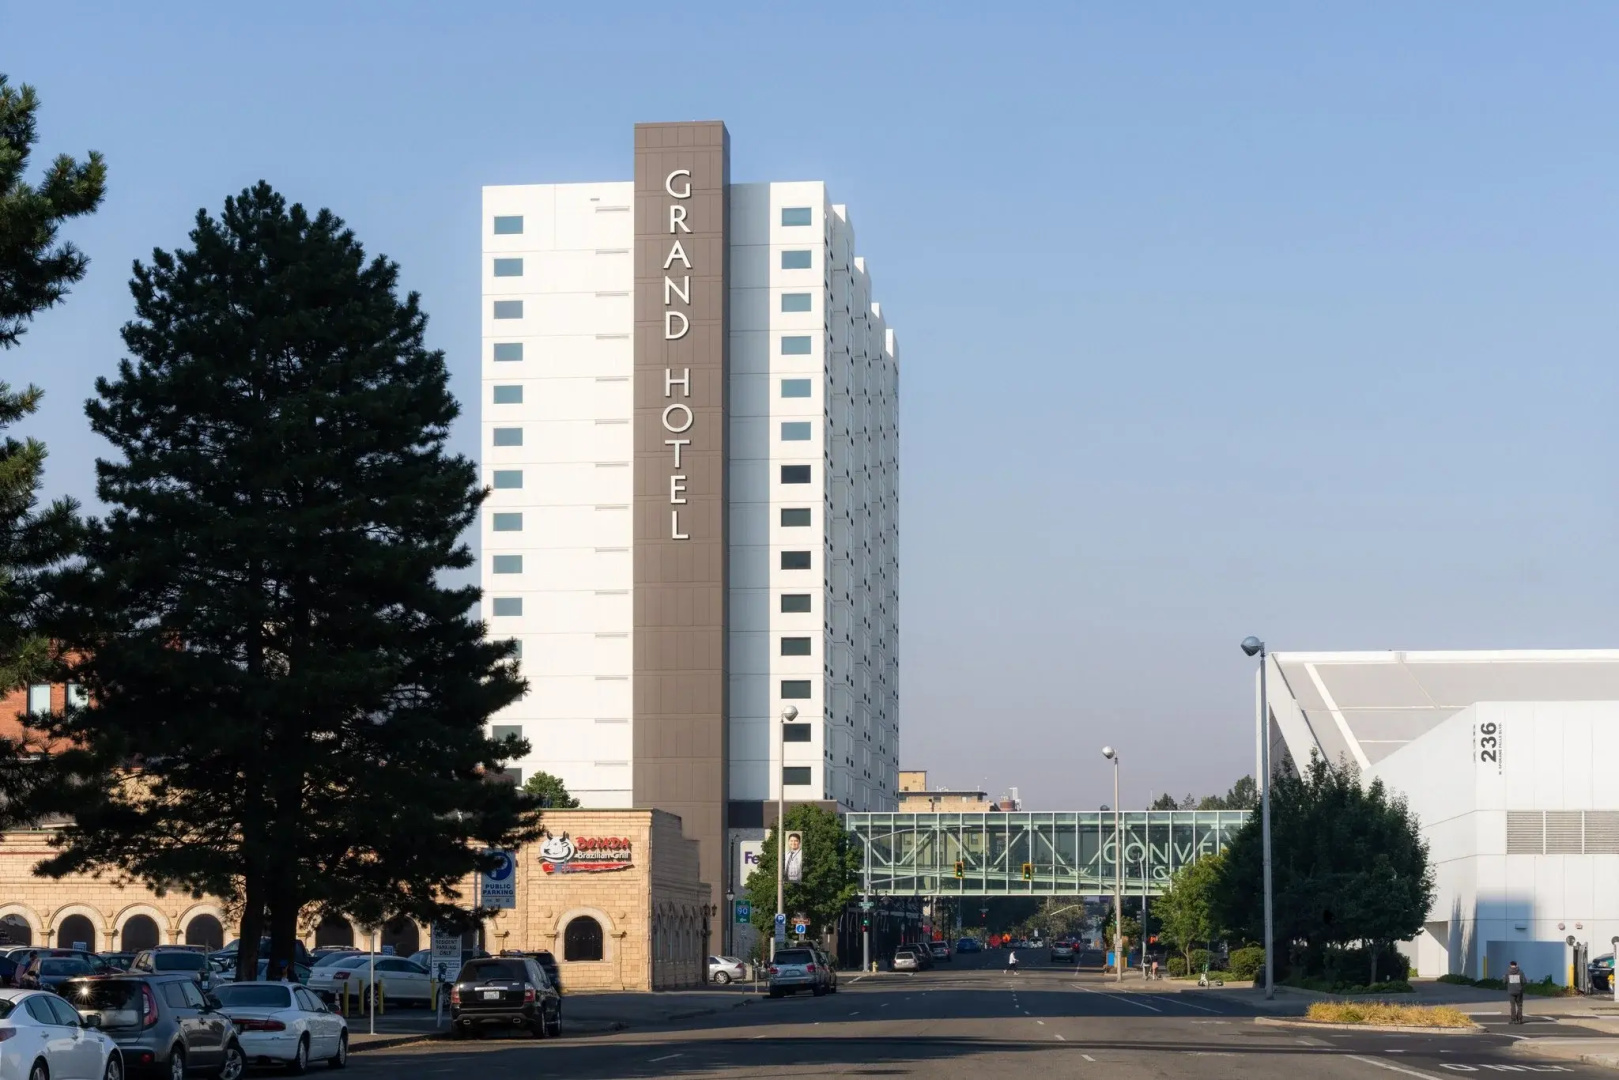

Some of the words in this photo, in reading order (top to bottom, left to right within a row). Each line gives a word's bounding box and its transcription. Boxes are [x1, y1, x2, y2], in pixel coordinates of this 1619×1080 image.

[664, 169, 693, 340] GRAND
[662, 367, 694, 540] HOTEL
[1480, 722, 1497, 762] 236
[577, 851, 608, 859] Brazilian
[1103, 842, 1228, 864] CONVE
[737, 907, 748, 915] 90
